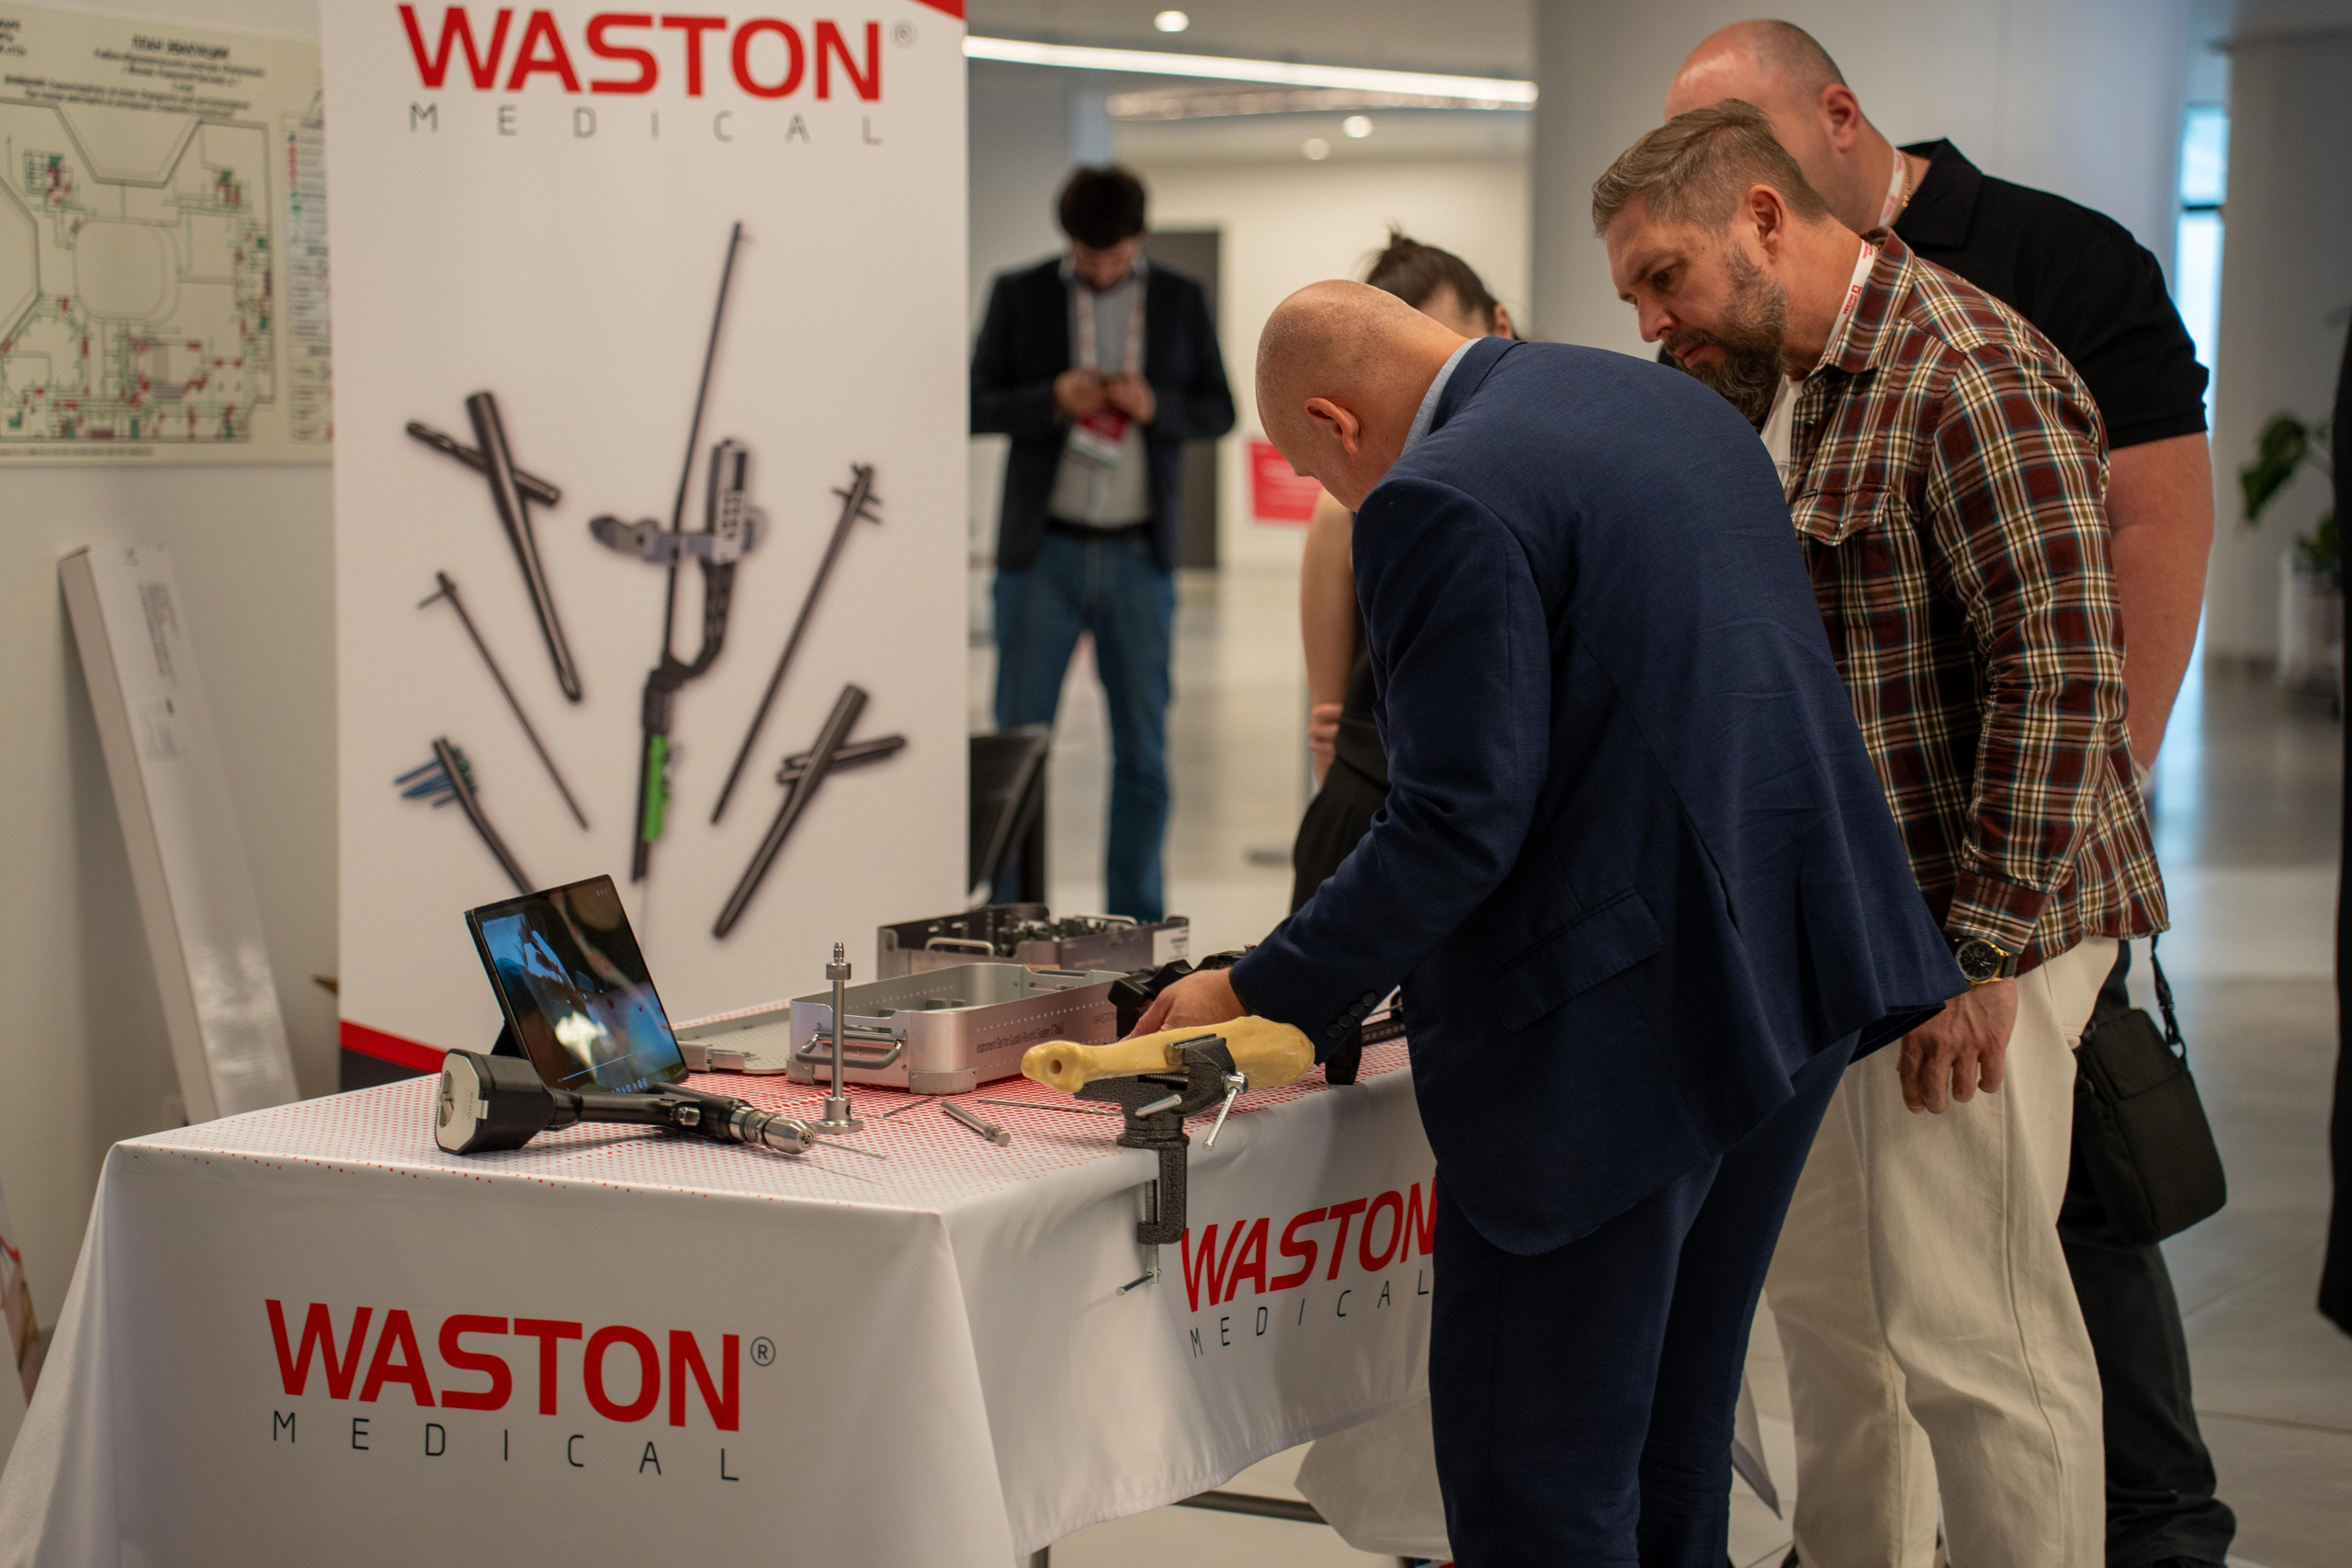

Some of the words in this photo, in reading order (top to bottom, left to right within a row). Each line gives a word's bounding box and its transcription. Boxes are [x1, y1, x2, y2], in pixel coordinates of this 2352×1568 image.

[398, 4, 883, 101] WASTON
[410, 102, 882, 145] MEDICAL
[1181, 1178, 1437, 1313] WASTON
[1190, 1269, 1430, 1359] MEDICAL
[265, 1299, 741, 1432] WASTON
[273, 1411, 740, 1482] MEDICAL
